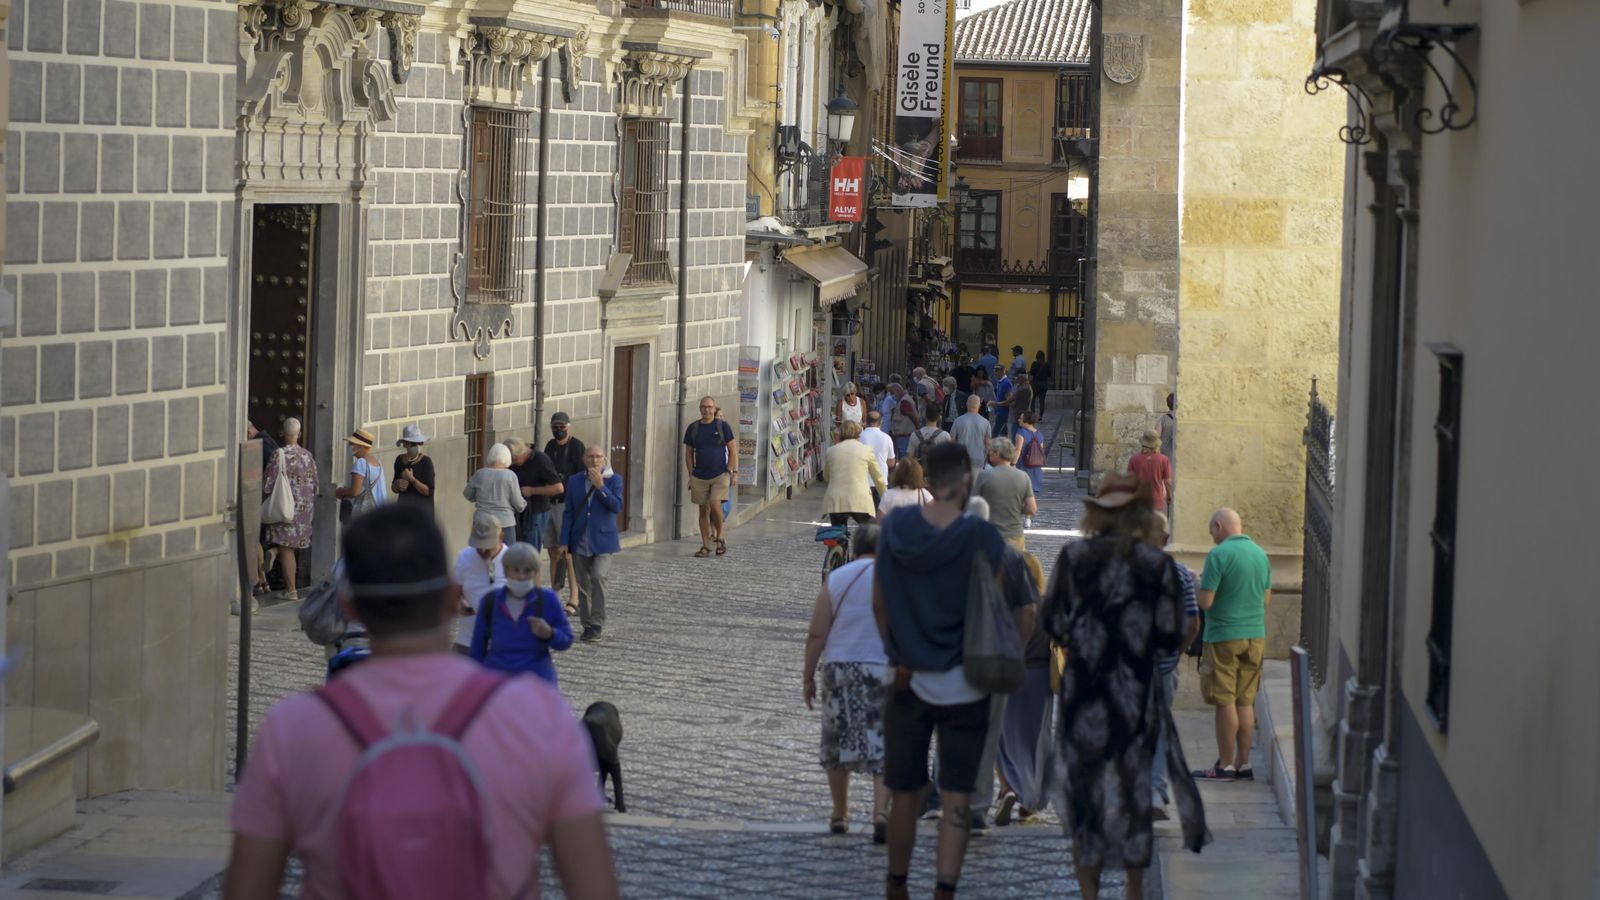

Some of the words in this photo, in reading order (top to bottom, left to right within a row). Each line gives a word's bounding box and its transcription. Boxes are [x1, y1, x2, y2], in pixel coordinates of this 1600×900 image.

[917, 0, 925, 14] so
[901, 52, 920, 111] Gisèle
[920, 43, 940, 111] Freund
[834, 177, 859, 193] HH
[834, 206, 857, 214] ALIVE
